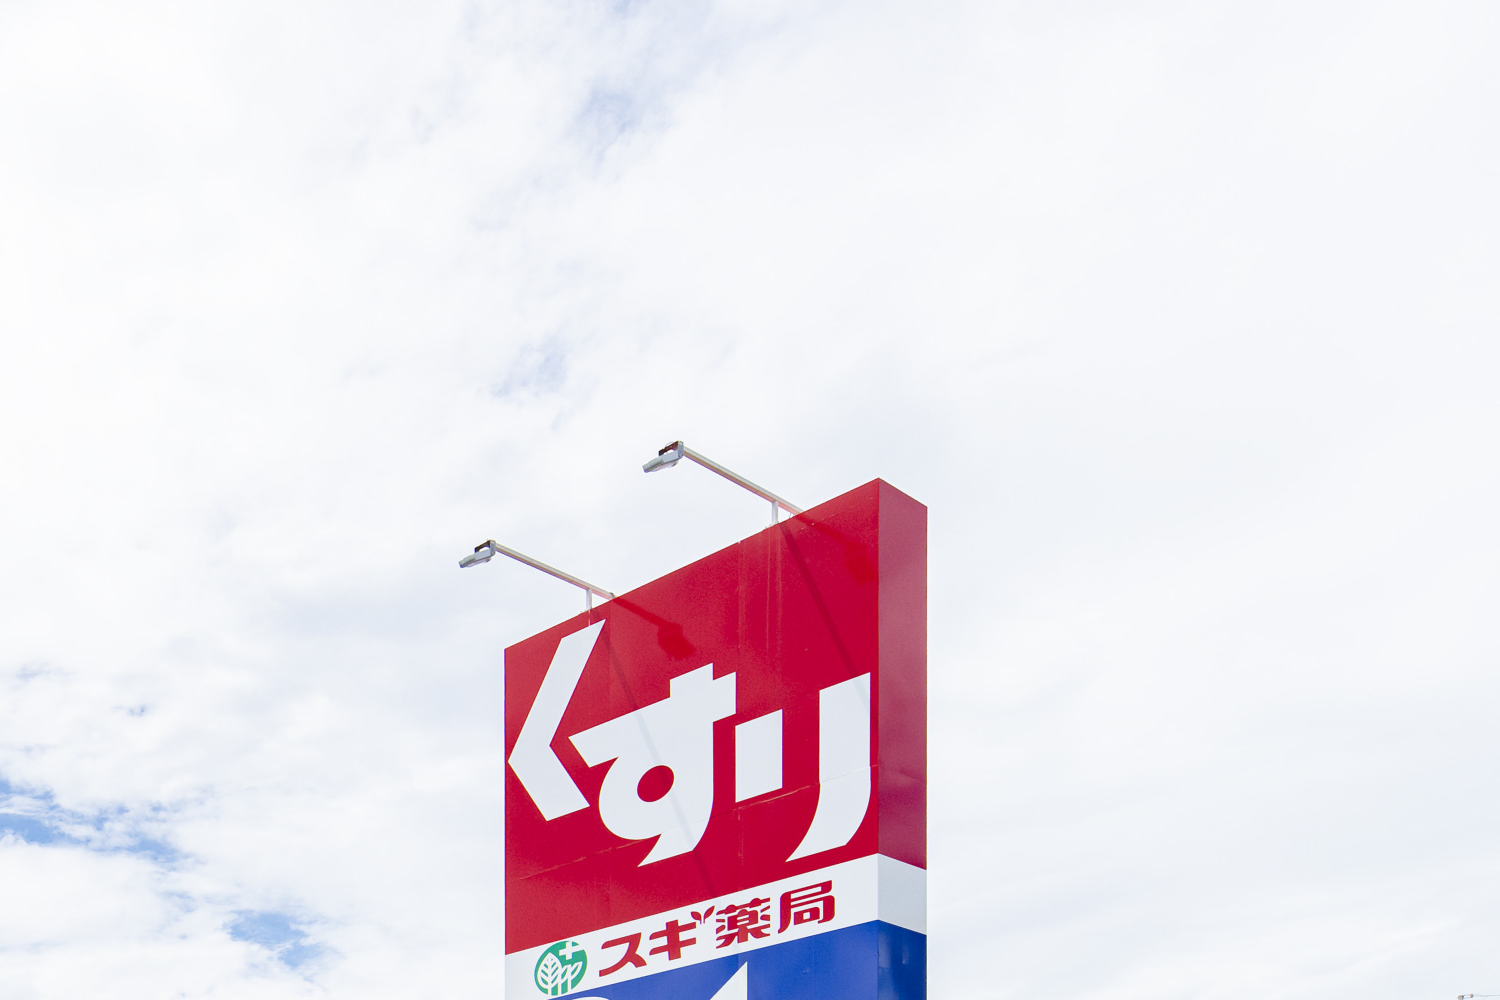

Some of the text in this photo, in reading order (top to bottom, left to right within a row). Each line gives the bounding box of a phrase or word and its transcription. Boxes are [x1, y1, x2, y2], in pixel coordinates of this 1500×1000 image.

[507, 618, 872, 868] くすり
[598, 879, 836, 978] スギ薬局
